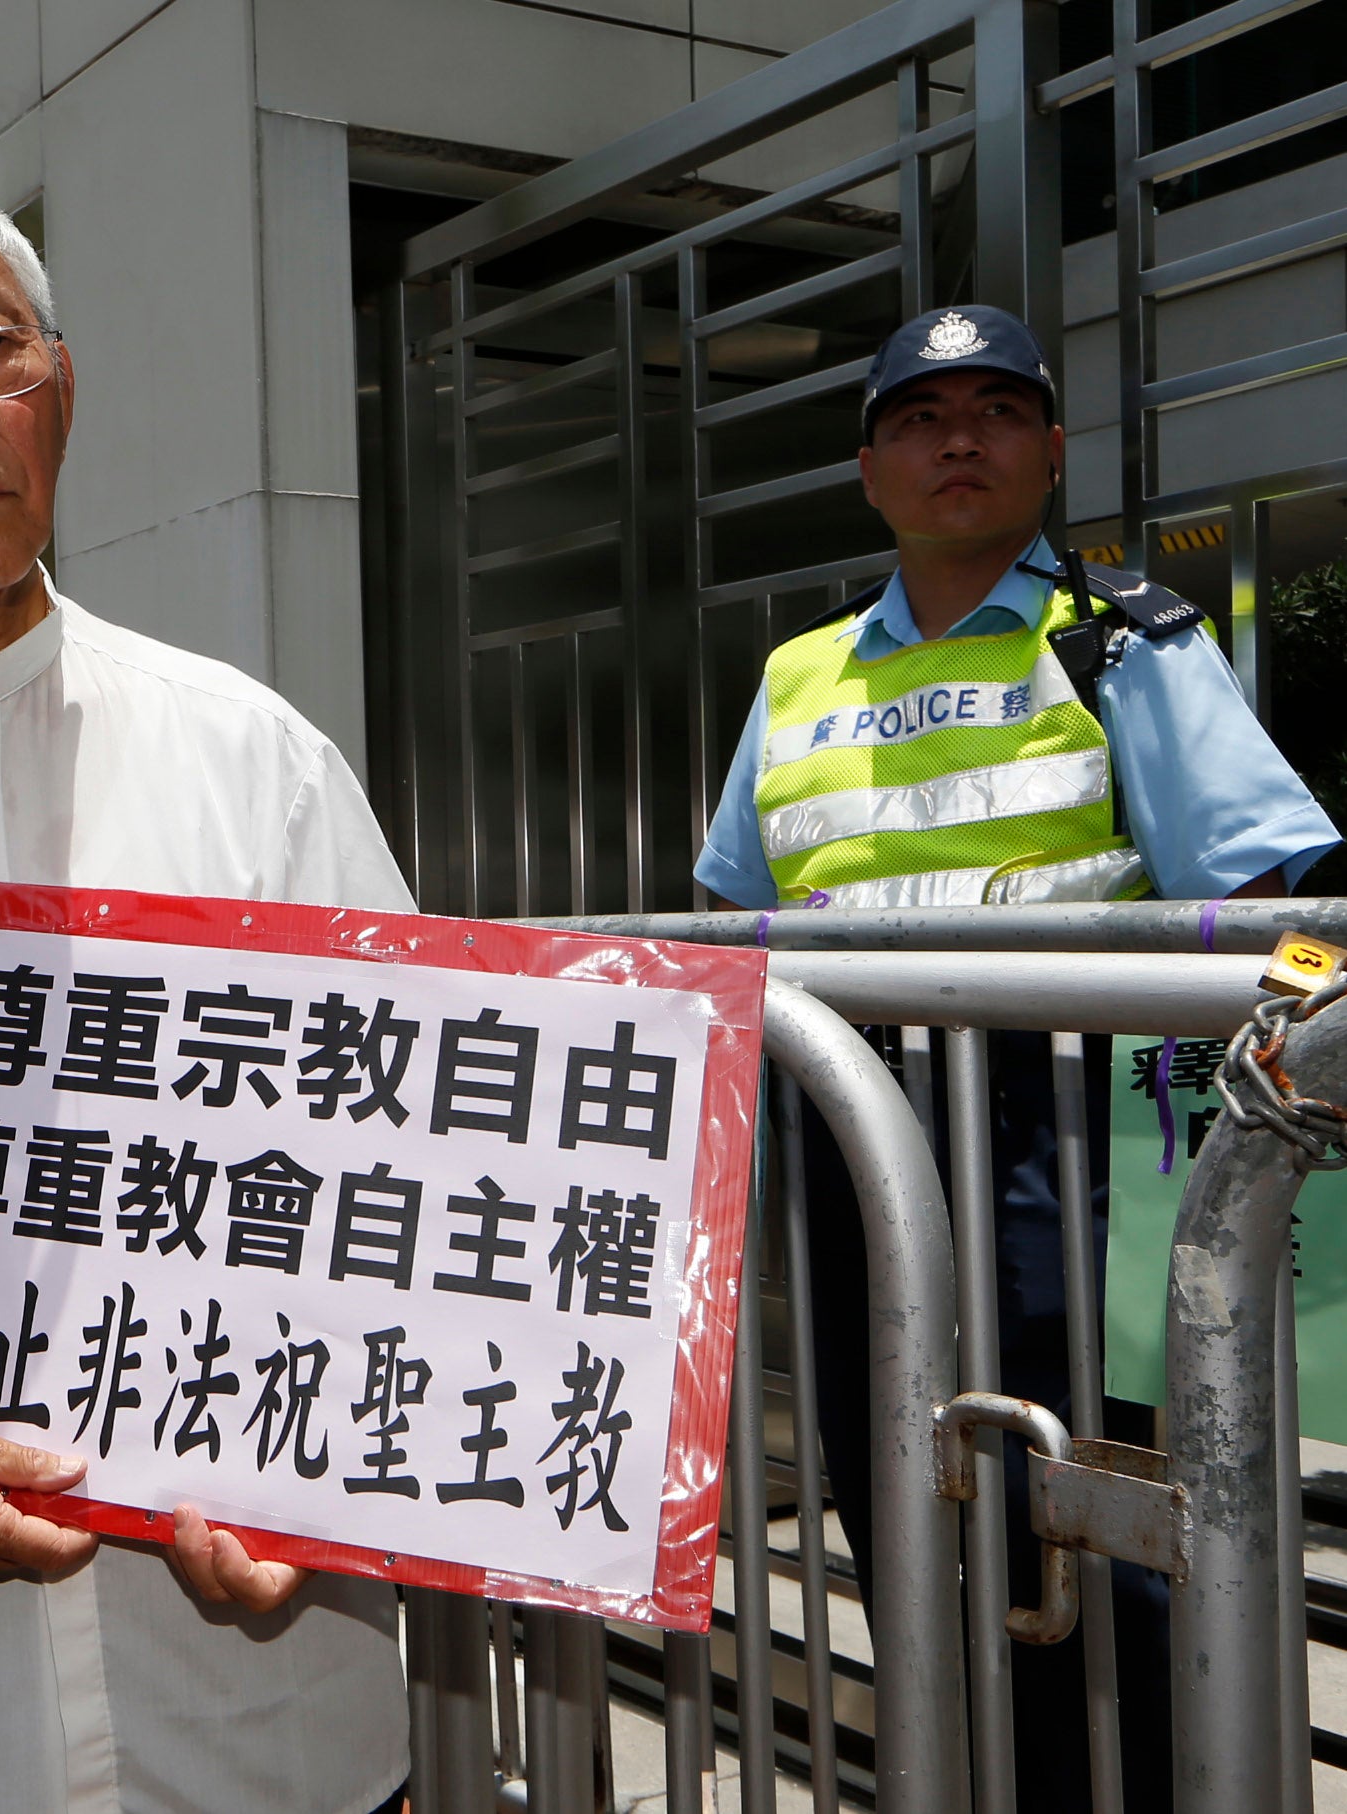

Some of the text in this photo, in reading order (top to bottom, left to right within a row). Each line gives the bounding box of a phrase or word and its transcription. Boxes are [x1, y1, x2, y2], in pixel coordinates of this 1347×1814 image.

[1153, 604, 1195, 626] 48063
[810, 683, 1032, 749] 警 POLICE 察
